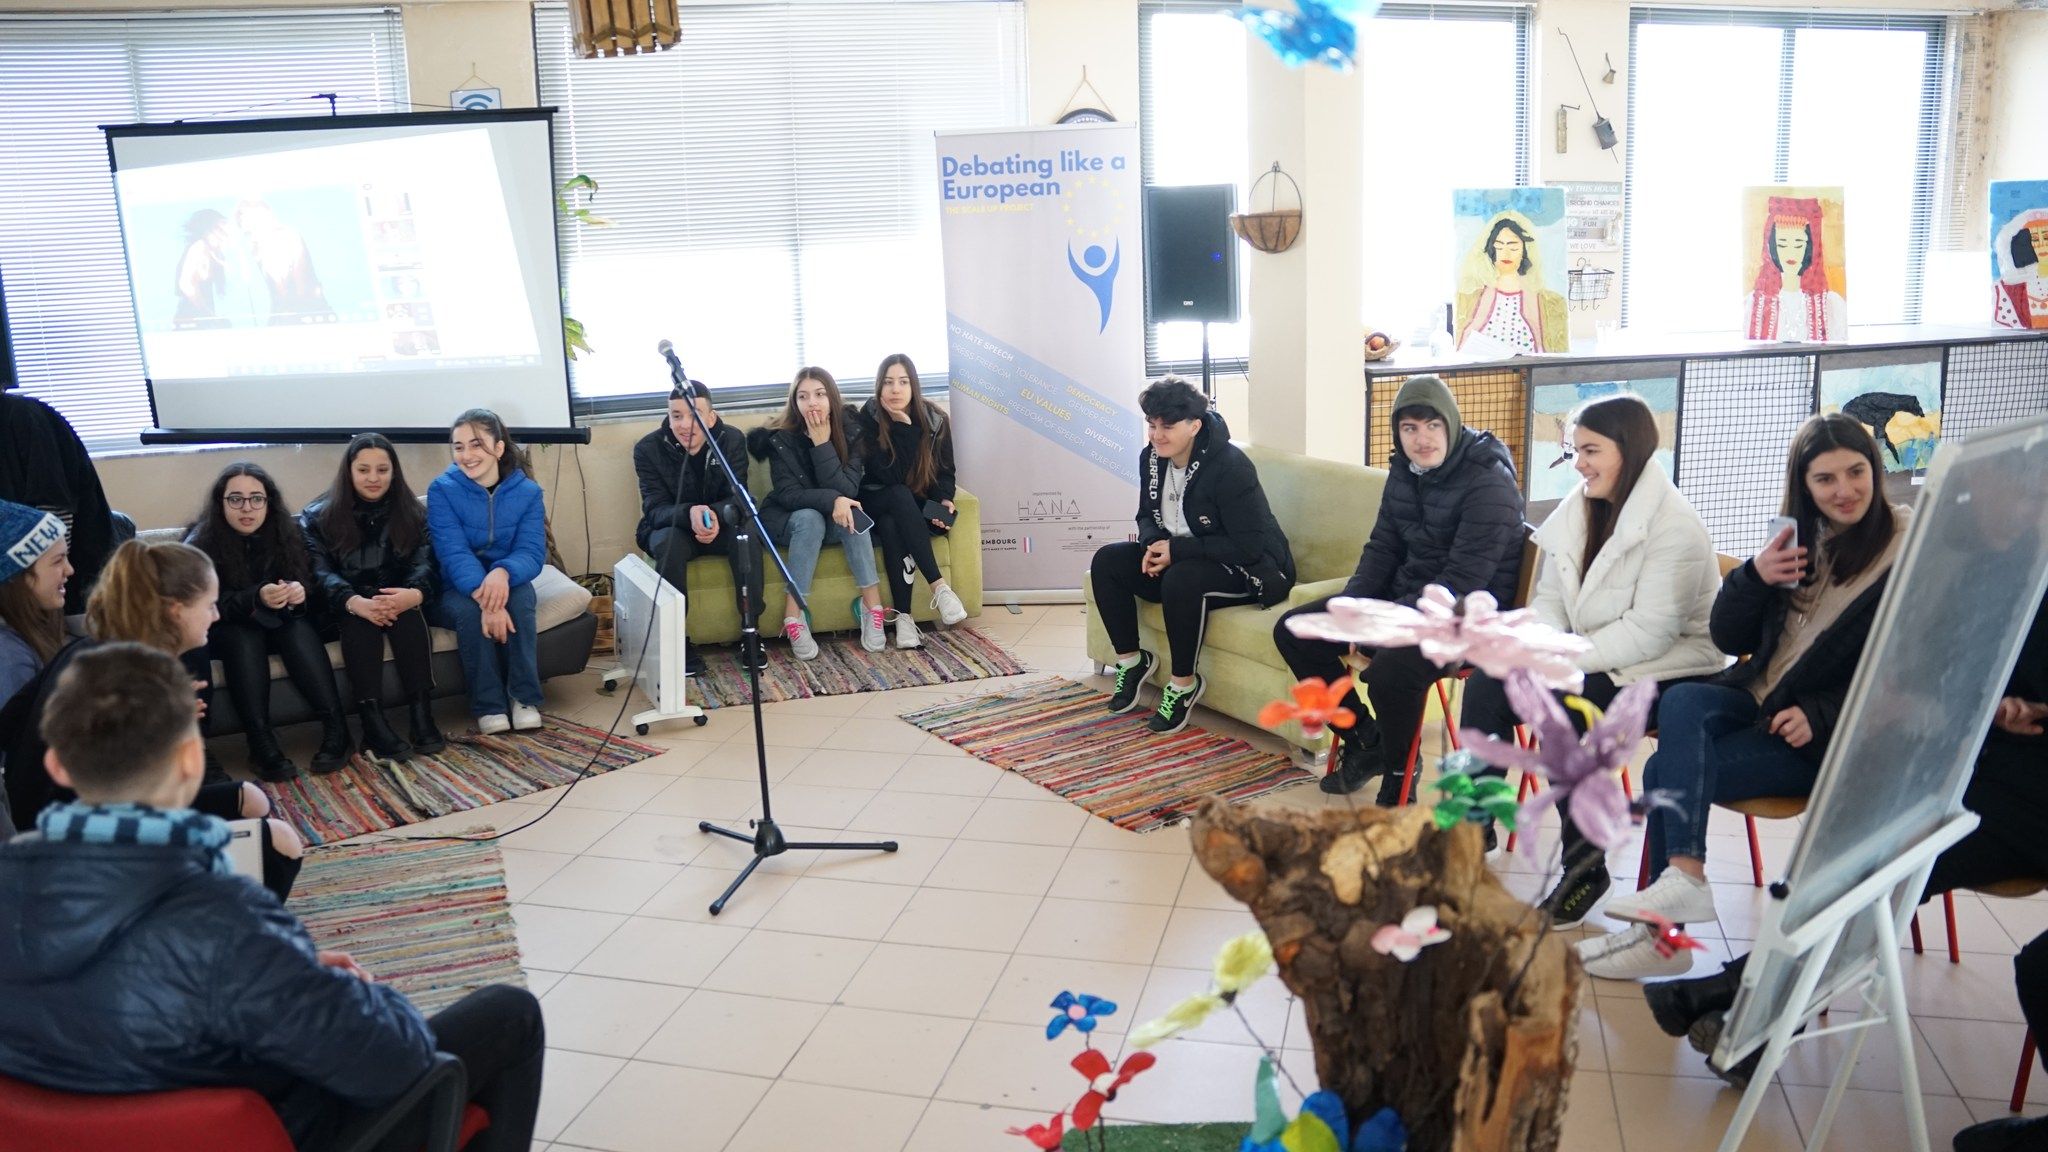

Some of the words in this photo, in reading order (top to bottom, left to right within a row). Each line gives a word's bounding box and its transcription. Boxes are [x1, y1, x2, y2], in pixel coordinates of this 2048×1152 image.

[942, 153, 1053, 179] Debating
[1060, 150, 1104, 172] like
[1111, 156, 1126, 170] a
[943, 179, 1061, 203] European
[949, 323, 962, 337] NO
[962, 330, 983, 346] HATE
[983, 341, 1014, 362] SPEECH
[952, 343, 975, 361] PRESS
[976, 355, 1012, 381] FREEDOM
[952, 379, 980, 401] HUMAN
[981, 396, 1010, 416] RIGHTS
[978, 378, 1006, 398] RIGHTS
[1015, 366, 1058, 395] TOLERANCE
[1020, 387, 1036, 402] EU
[1035, 396, 1073, 422] VALUES
[1065, 385, 1119, 417] DEMOCRACY
[1007, 400, 1043, 425] FREEDOM
[1057, 426, 1086, 448] SPEECH
[1067, 400, 1099, 421] GENDER
[1098, 418, 1136, 440] EQUALITY
[1084, 427, 1125, 453] DIVERSITY
[1089, 450, 1108, 465] RULE
[1149, 447, 1159, 500] GERFELD
[13, 519, 60, 567] NEW
